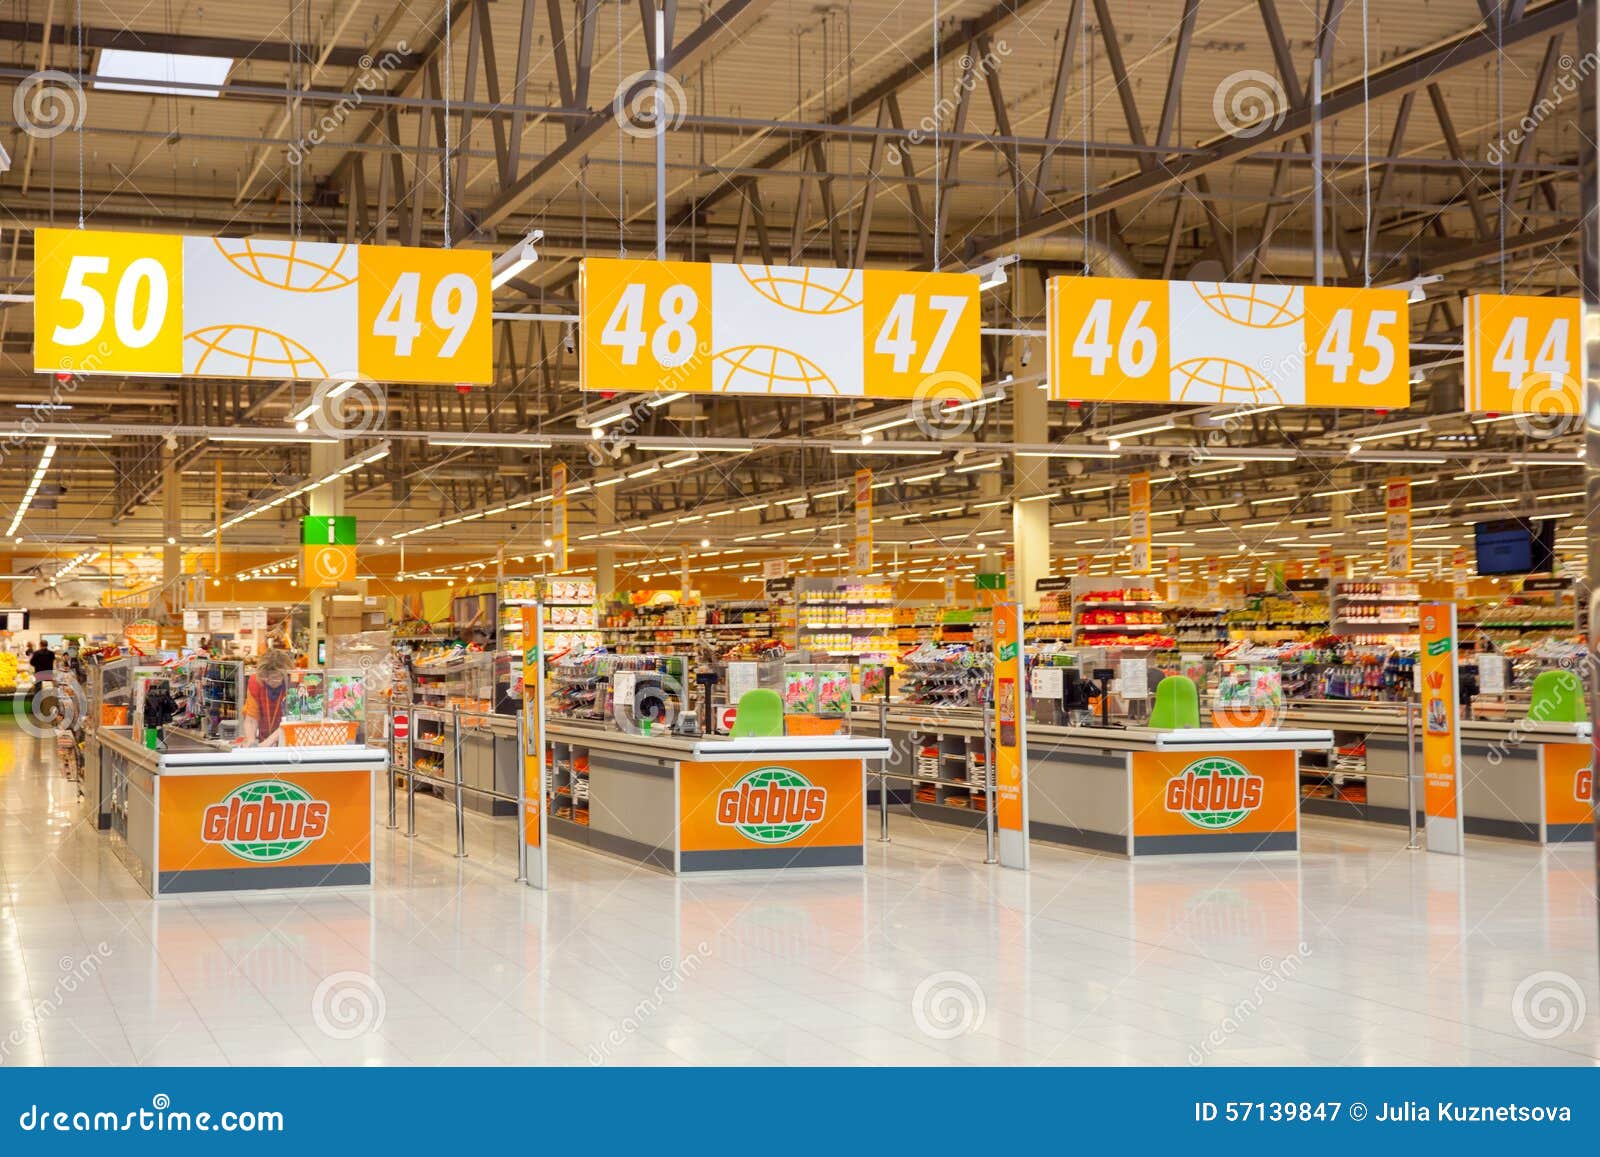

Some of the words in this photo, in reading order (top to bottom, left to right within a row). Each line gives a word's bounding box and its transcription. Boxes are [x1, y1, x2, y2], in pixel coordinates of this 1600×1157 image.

[52, 255, 168, 349] 50
[373, 272, 478, 358] 49
[601, 283, 698, 368] 48
[874, 293, 968, 373] 47
[1072, 299, 1158, 378] 46
[1315, 308, 1397, 385] 45
[1492, 317, 1570, 391] 44
[203, 795, 328, 841] Globus
[718, 780, 825, 824] Globus
[1166, 770, 1262, 811] Globus
